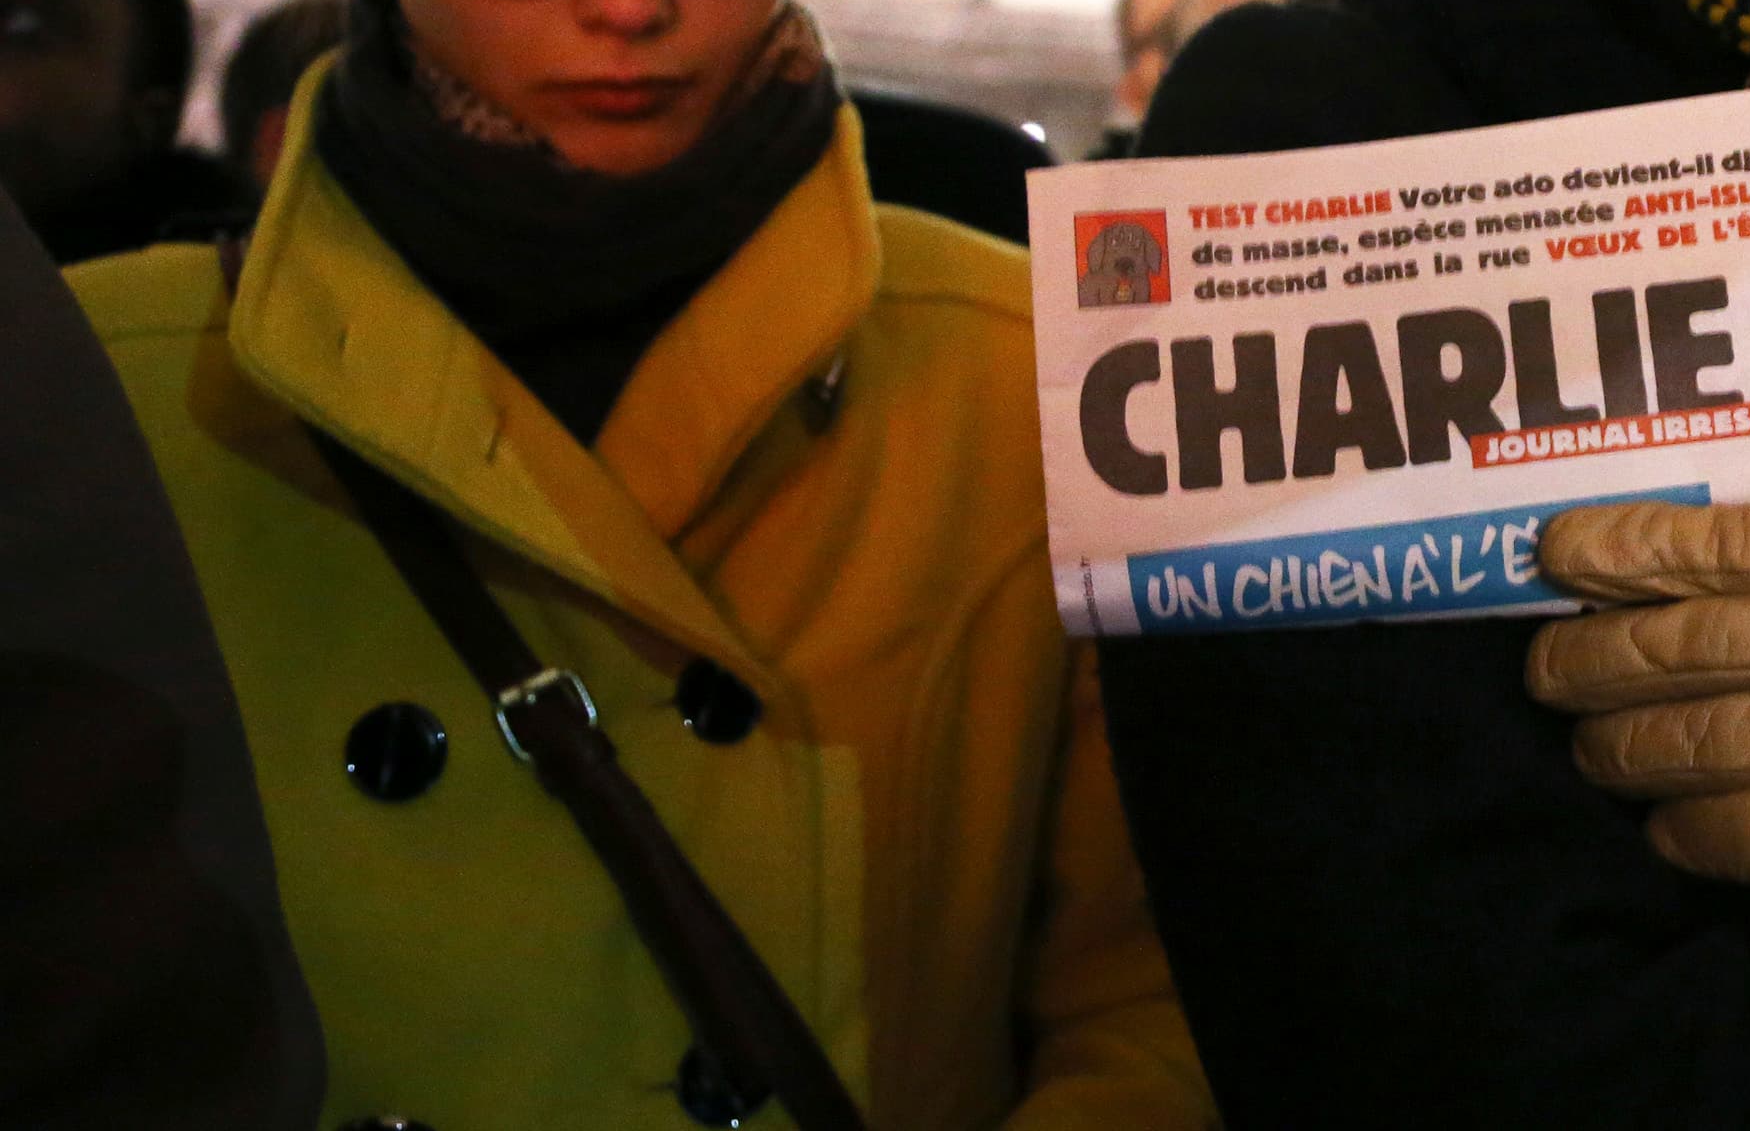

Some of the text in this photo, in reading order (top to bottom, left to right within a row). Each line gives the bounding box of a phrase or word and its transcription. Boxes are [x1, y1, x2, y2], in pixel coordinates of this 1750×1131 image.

[1188, 202, 1257, 229] TEST
[1264, 189, 1393, 224] CHARLIE
[1399, 182, 1486, 209] Votre
[1494, 173, 1554, 198] ado
[1562, 152, 1714, 191] devient-il
[1192, 239, 1233, 265] de
[1242, 233, 1349, 263] masse,
[1358, 218, 1467, 249] espèce
[1475, 200, 1615, 236] menacée
[1194, 266, 1328, 300] descend
[1342, 259, 1419, 286] dans
[1433, 251, 1463, 276] la
[1478, 246, 1531, 269] rue
[1545, 228, 1643, 262] VŒUX
[1657, 222, 1698, 248] DE
[1079, 275, 1744, 496] CHARLIE
[1486, 420, 1646, 464] JOURNAL
[1147, 561, 1224, 620] UN
[1232, 544, 1392, 620] CHIEN
